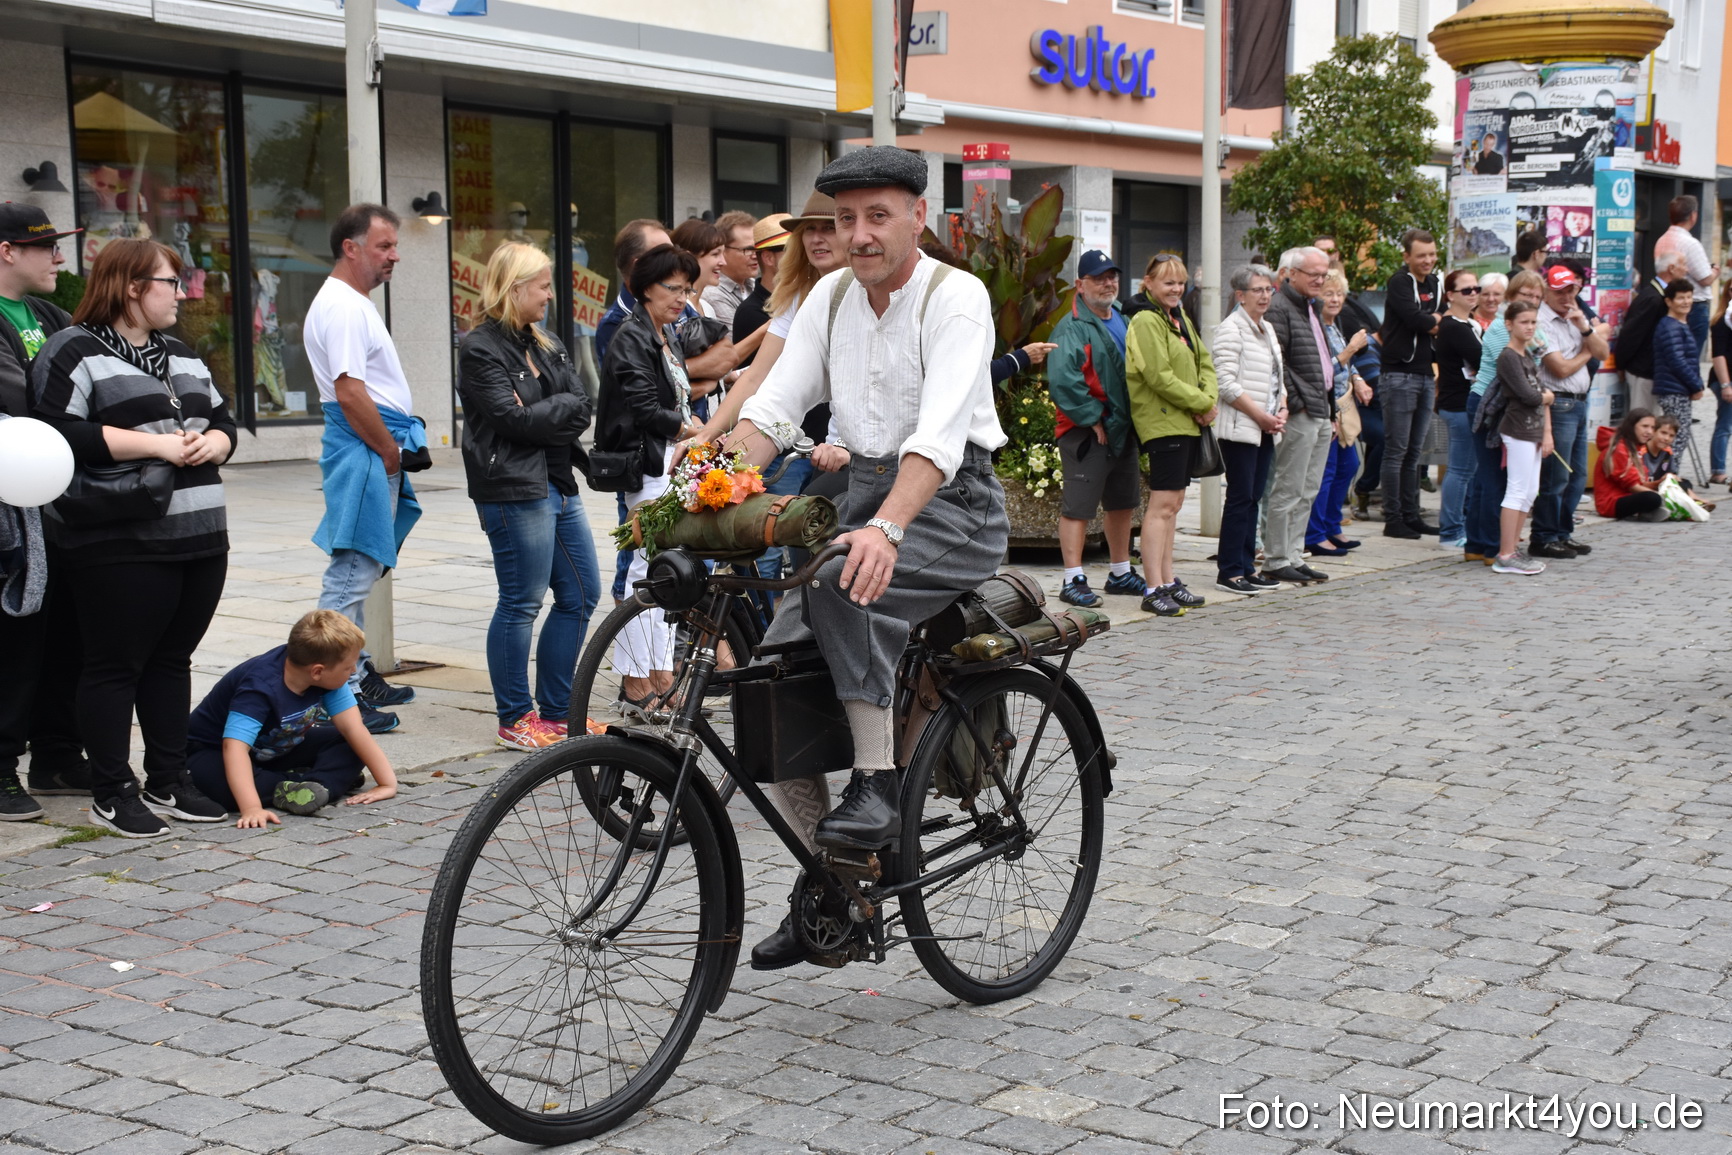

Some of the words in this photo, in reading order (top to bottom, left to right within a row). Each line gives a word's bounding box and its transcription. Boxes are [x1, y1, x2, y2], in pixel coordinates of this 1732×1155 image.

[1040, 25, 1156, 98] sutor.
[453, 114, 491, 134] SALE
[1511, 114, 1536, 126] ADAC
[454, 169, 492, 189] SALE
[455, 196, 493, 215] SALE
[452, 260, 483, 290] SAL
[573, 269, 607, 302] SALE
[452, 295, 472, 315] SA
